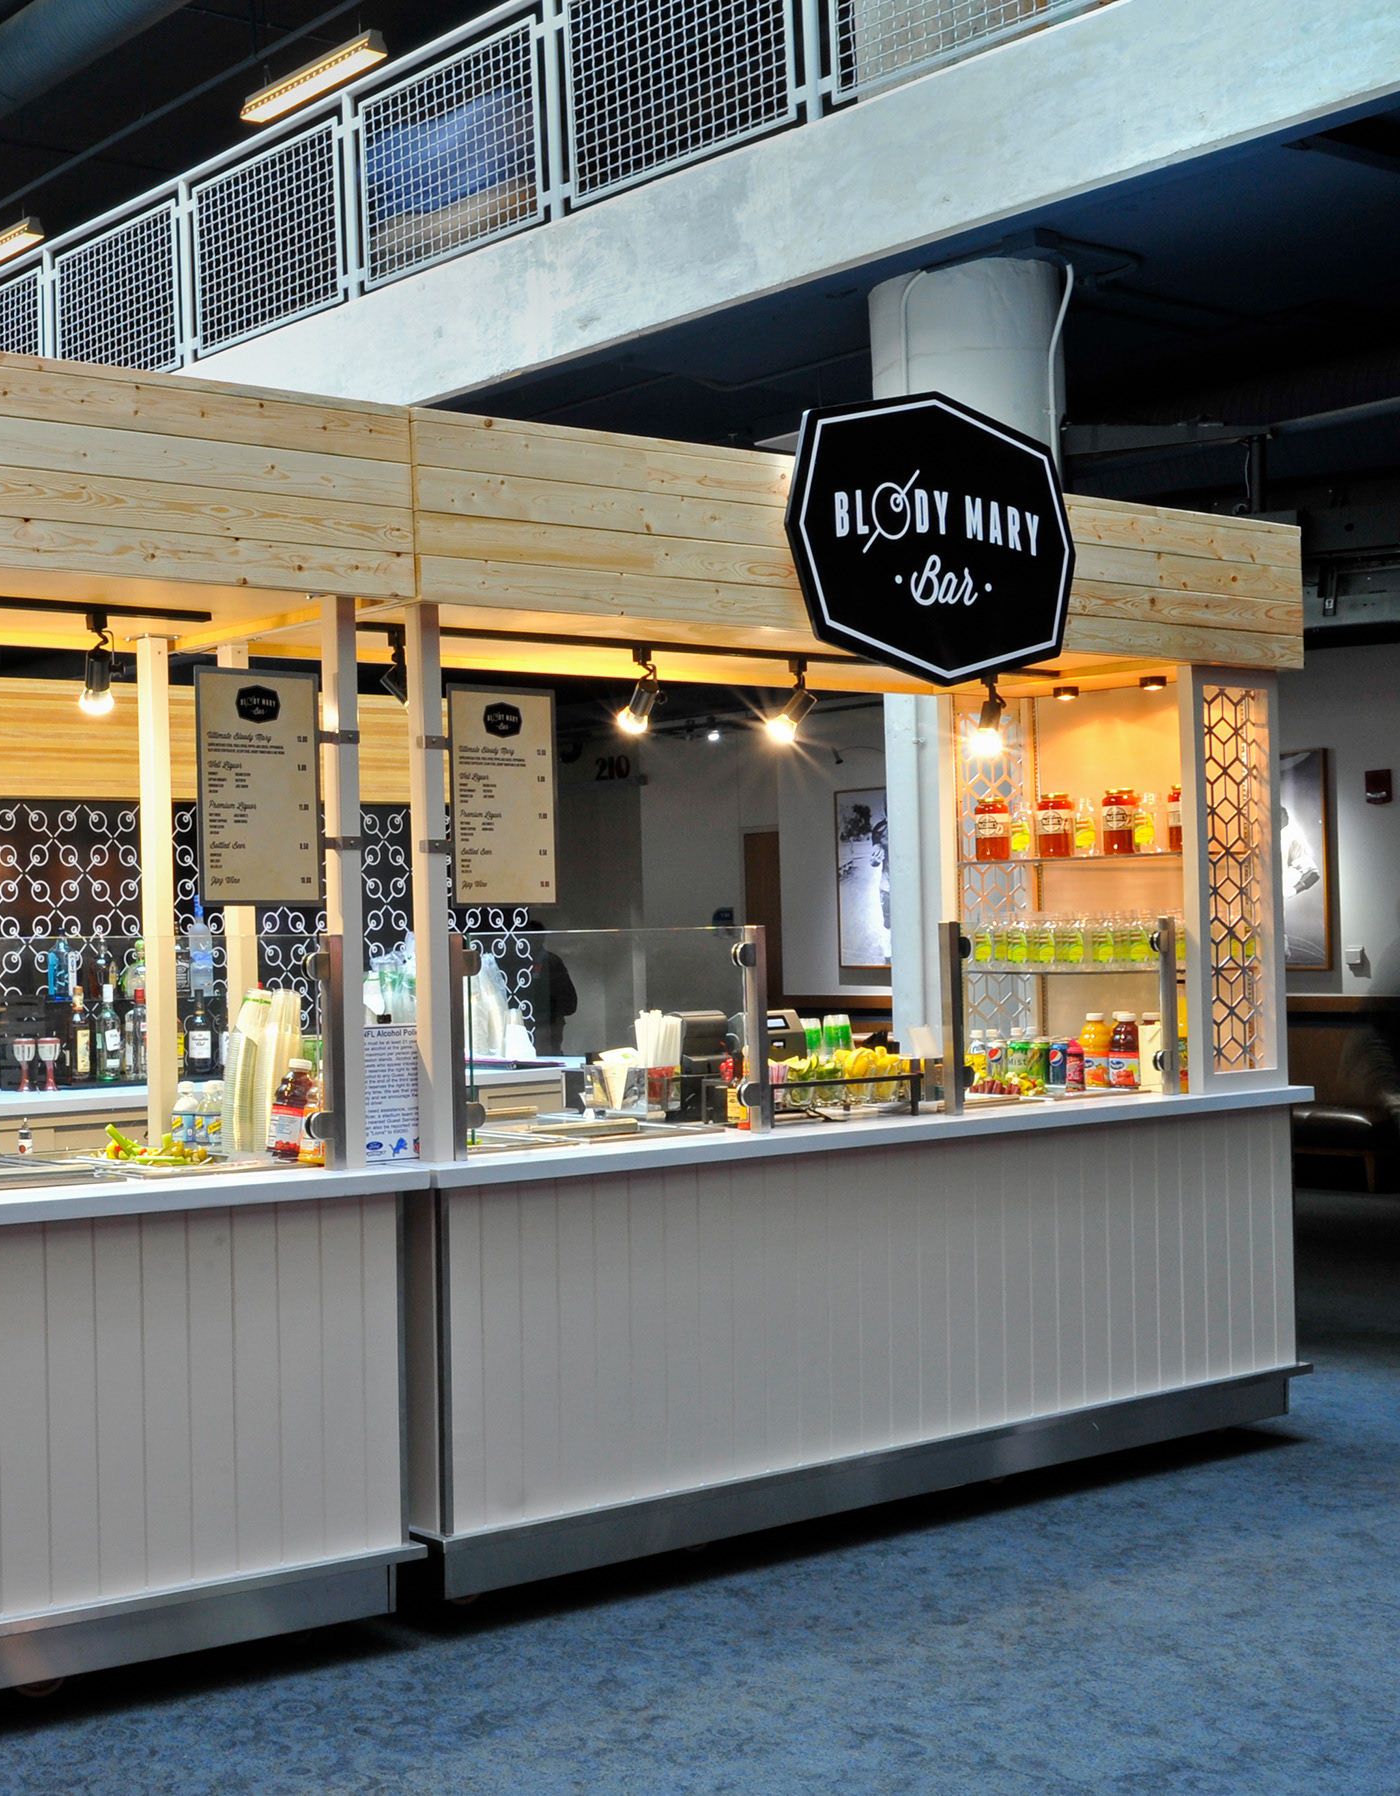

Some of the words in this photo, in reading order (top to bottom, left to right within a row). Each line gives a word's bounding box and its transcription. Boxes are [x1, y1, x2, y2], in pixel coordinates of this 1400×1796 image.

[834, 478, 949, 546] BLOODY
[964, 494, 1040, 556] MARY
[910, 554, 979, 606] Bar
[595, 755, 631, 781] 210
[377, 1029, 402, 1037] Alcohol
